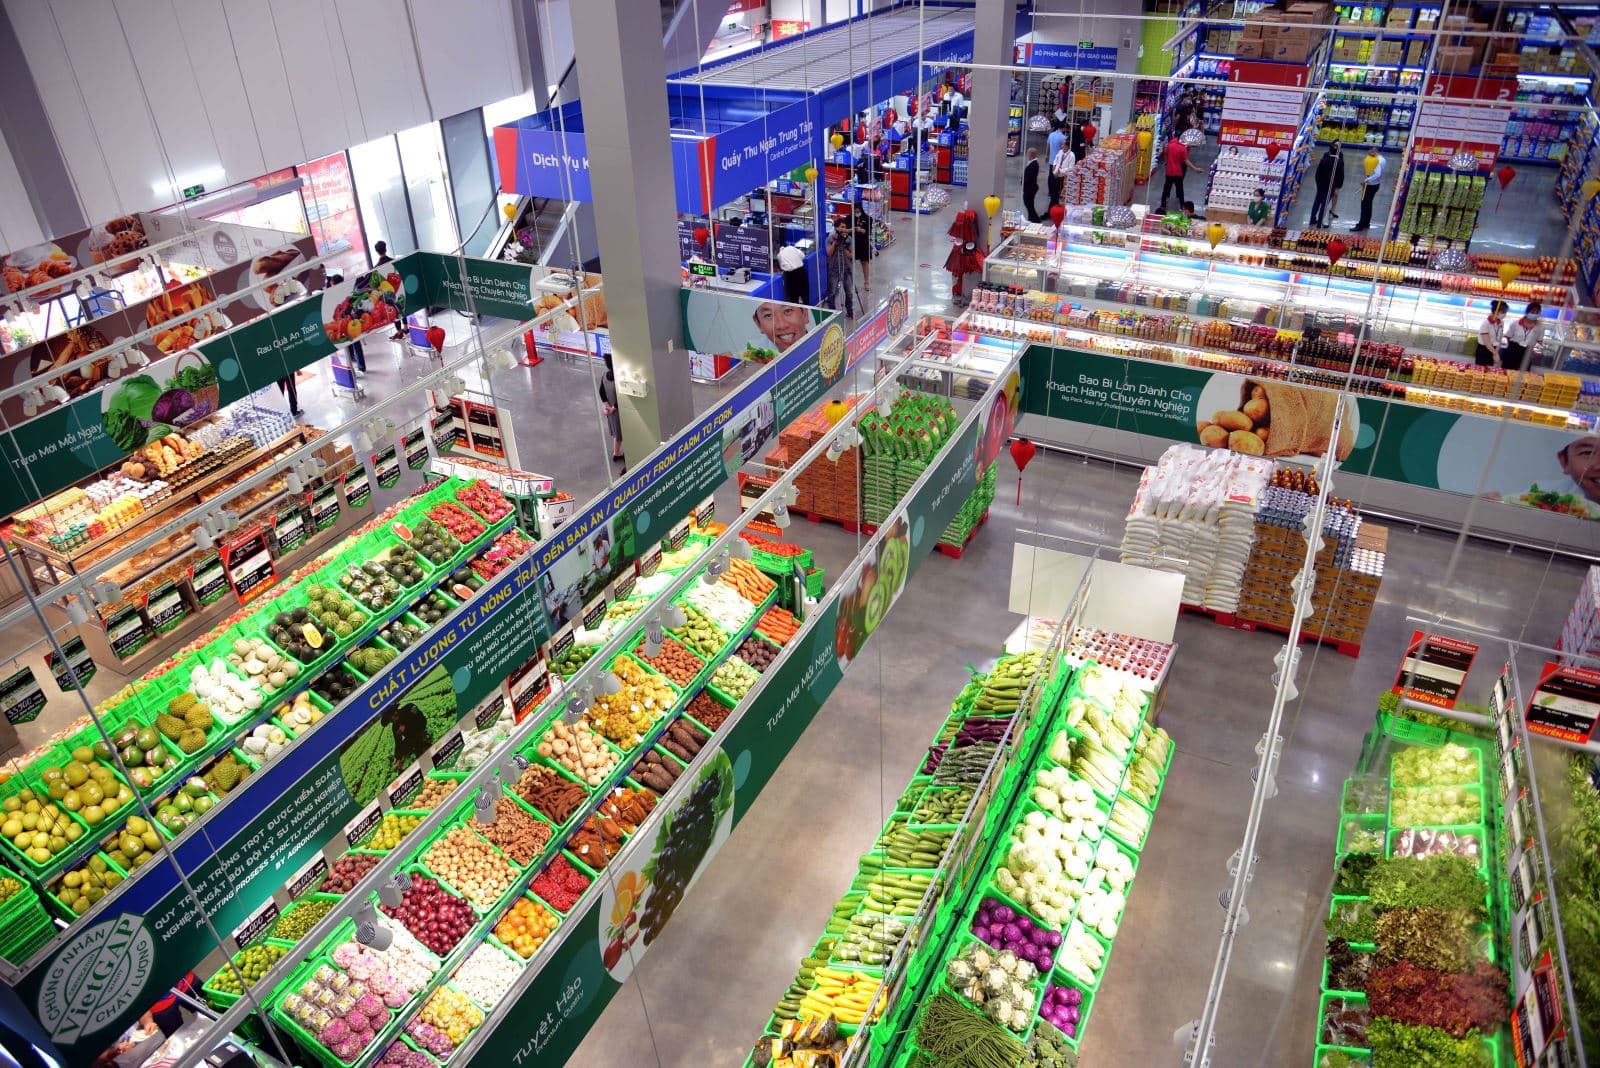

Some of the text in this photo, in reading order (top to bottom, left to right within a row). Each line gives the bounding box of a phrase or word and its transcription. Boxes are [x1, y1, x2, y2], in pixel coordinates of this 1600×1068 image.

[1234, 69, 1302, 86] 1 1
[1431, 83, 1510, 102] 2 2
[743, 145, 758, 160] Thu
[779, 128, 798, 144] Trung
[532, 152, 559, 169] Dịch
[562, 155, 580, 172] Vụ
[256, 344, 272, 357] Rau
[290, 332, 300, 342] An
[1046, 380, 1078, 394] Khách
[1080, 386, 1107, 401] Hàng
[1110, 391, 1151, 406] Chuyên
[1079, 374, 1099, 386] Bao
[1103, 377, 1113, 388] Bì
[1139, 384, 1167, 397] Dành
[1171, 389, 1192, 402] Cho
[369, 669, 407, 709] CHẤT
[410, 629, 457, 676] LƯỢNG
[458, 611, 478, 633] TỪ
[480, 583, 512, 617] NÔNG
[542, 540, 565, 566] ĐẾN
[566, 522, 588, 546] BÀN
[606, 501, 611, 515] /
[614, 471, 652, 508] QUALITY
[653, 451, 677, 476] FROM
[678, 431, 701, 457] FARM
[702, 422, 712, 437] TO
[713, 406, 733, 428] FORK
[469, 640, 482, 654] THU
[482, 621, 505, 643] HOẠCH
[270, 828, 302, 861] STRICTLY
[303, 788, 346, 830] CONTROLLED
[291, 802, 314, 826] NÔNG
[155, 907, 175, 930] QUY
[178, 880, 208, 908] TRNH
[241, 829, 265, 853] TRỌT
[315, 764, 337, 788] SOÁT
[275, 856, 286, 870] BY
[330, 798, 350, 818] TEAM
[56, 917, 136, 1036] VietGAP
[513, 976, 582, 1064] Tuyệt Hảo
